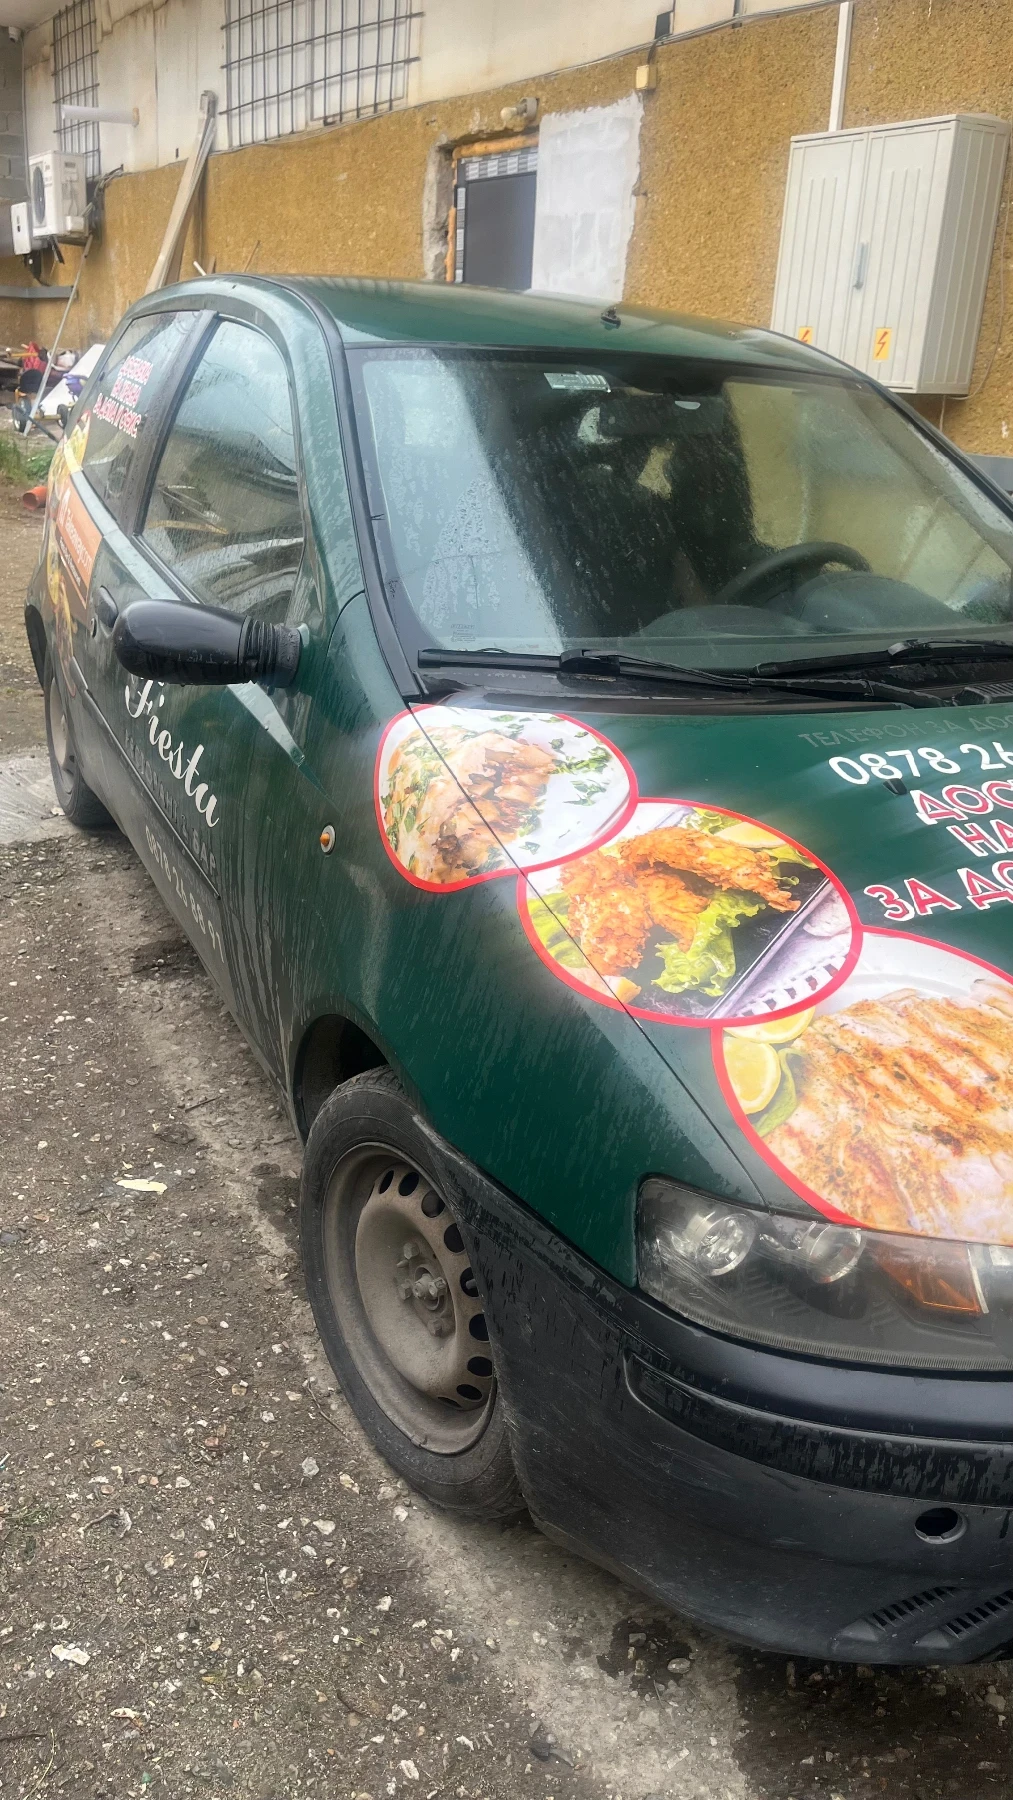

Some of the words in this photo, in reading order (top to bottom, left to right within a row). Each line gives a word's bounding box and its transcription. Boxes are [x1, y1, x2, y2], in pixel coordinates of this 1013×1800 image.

[797, 722, 926, 748] ТЕЛЕФОН
[924, 719, 967, 735] ЗА
[828, 746, 961, 785] 0878
[909, 779, 1013, 825] ДОС
[172, 865, 188, 908] 26
[189, 892, 206, 925] 88
[863, 877, 962, 921] ЗА
